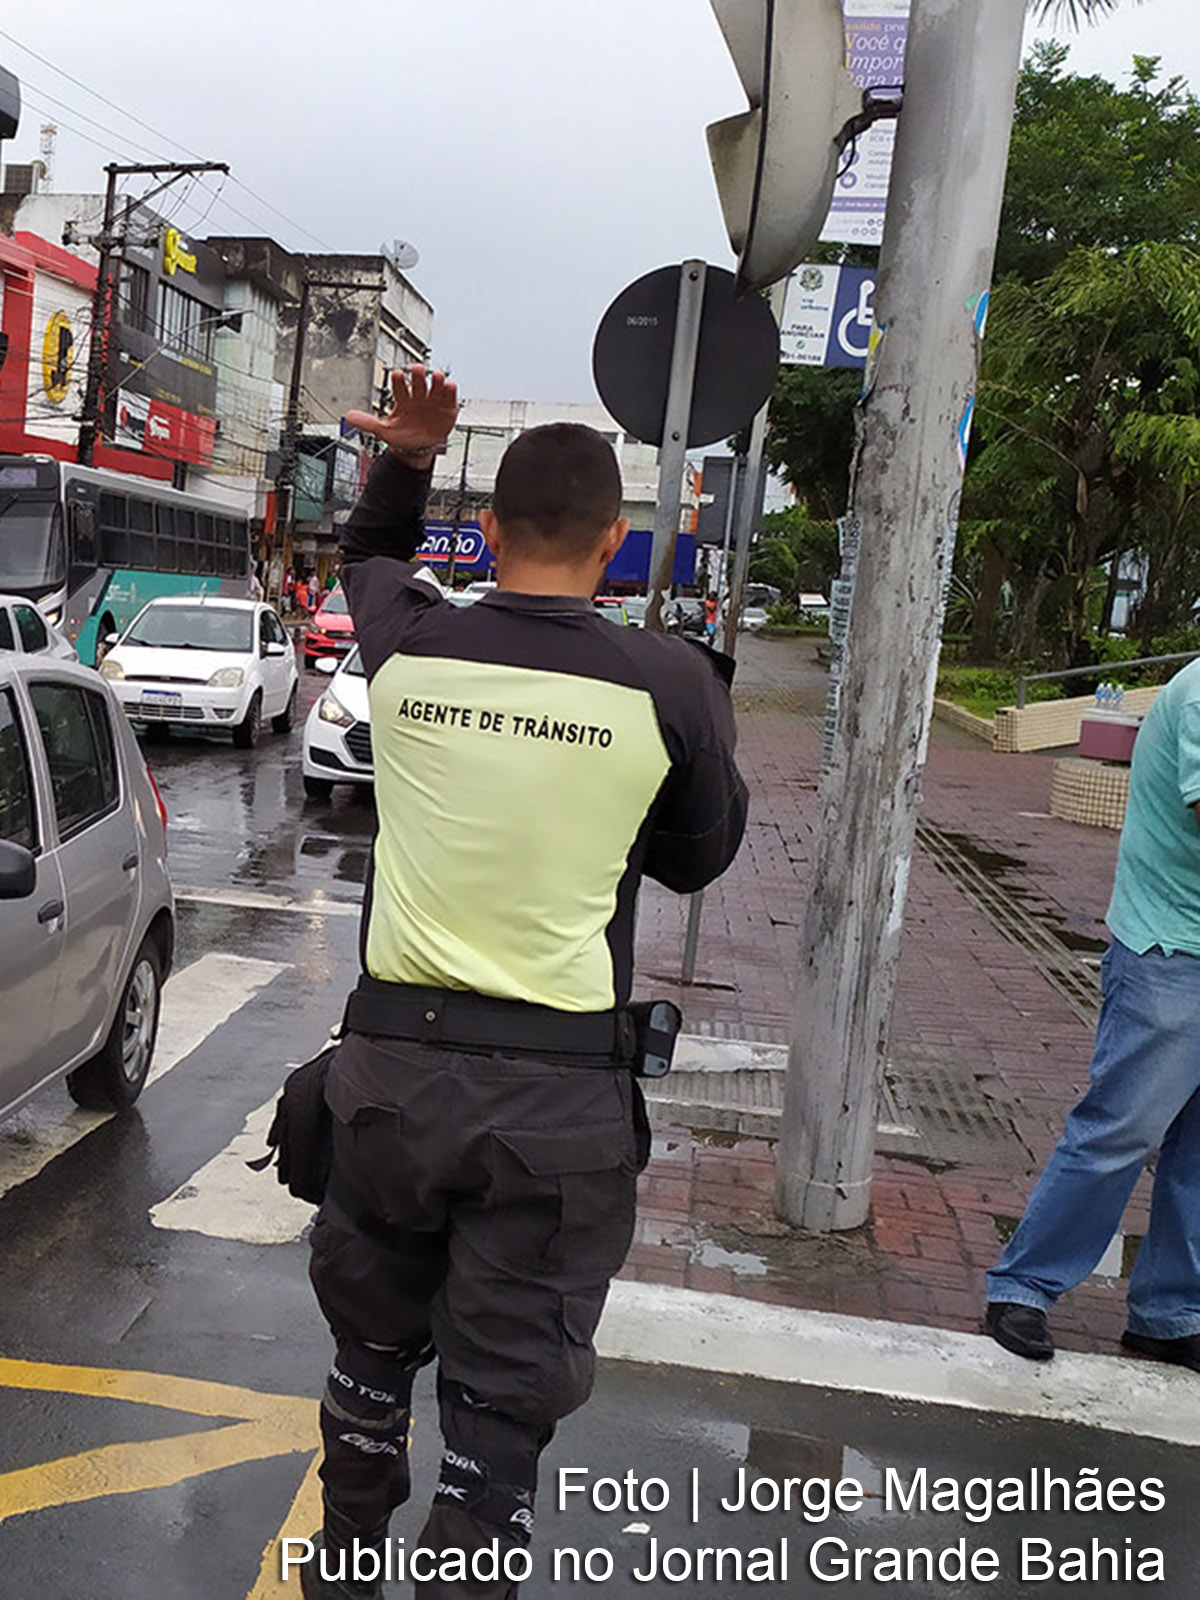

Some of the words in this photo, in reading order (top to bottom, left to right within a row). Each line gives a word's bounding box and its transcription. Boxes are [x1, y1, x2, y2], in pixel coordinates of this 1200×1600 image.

[398, 698, 472, 728] AGENTE
[479, 711, 505, 732] DE
[512, 715, 613, 748] TRÂNSITO
